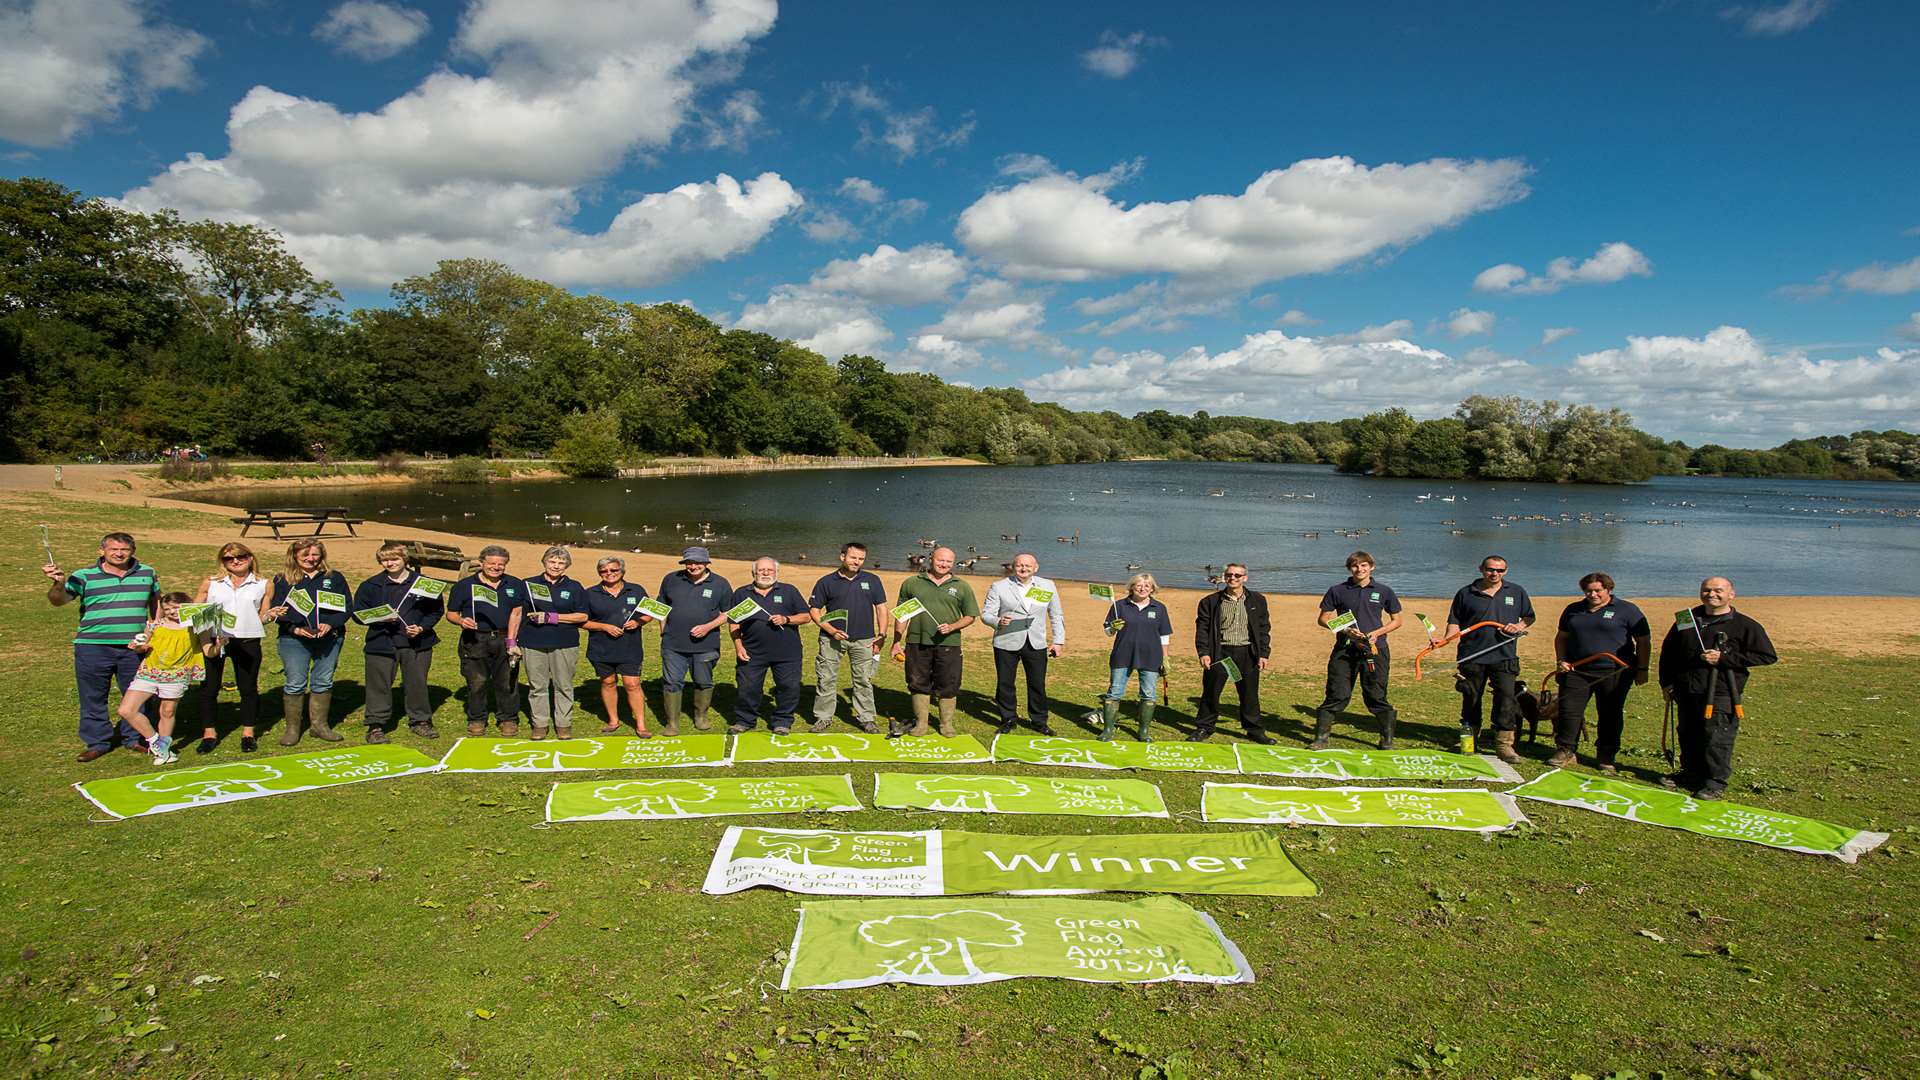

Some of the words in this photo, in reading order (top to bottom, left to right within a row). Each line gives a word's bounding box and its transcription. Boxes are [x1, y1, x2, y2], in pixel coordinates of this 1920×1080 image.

[852, 835, 908, 847] Green
[851, 844, 892, 856] Flag
[849, 854, 913, 863] Award
[983, 850, 1253, 873] Winner
[726, 864, 755, 877] the
[762, 864, 810, 880] mark
[816, 872, 836, 880] of
[861, 872, 927, 883] quality
[776, 879, 793, 887] or
[801, 880, 858, 891] green
[867, 881, 922, 891] space
[1055, 917, 1140, 929] Green
[1060, 930, 1123, 946] Flag
[1066, 945, 1166, 958] Award
